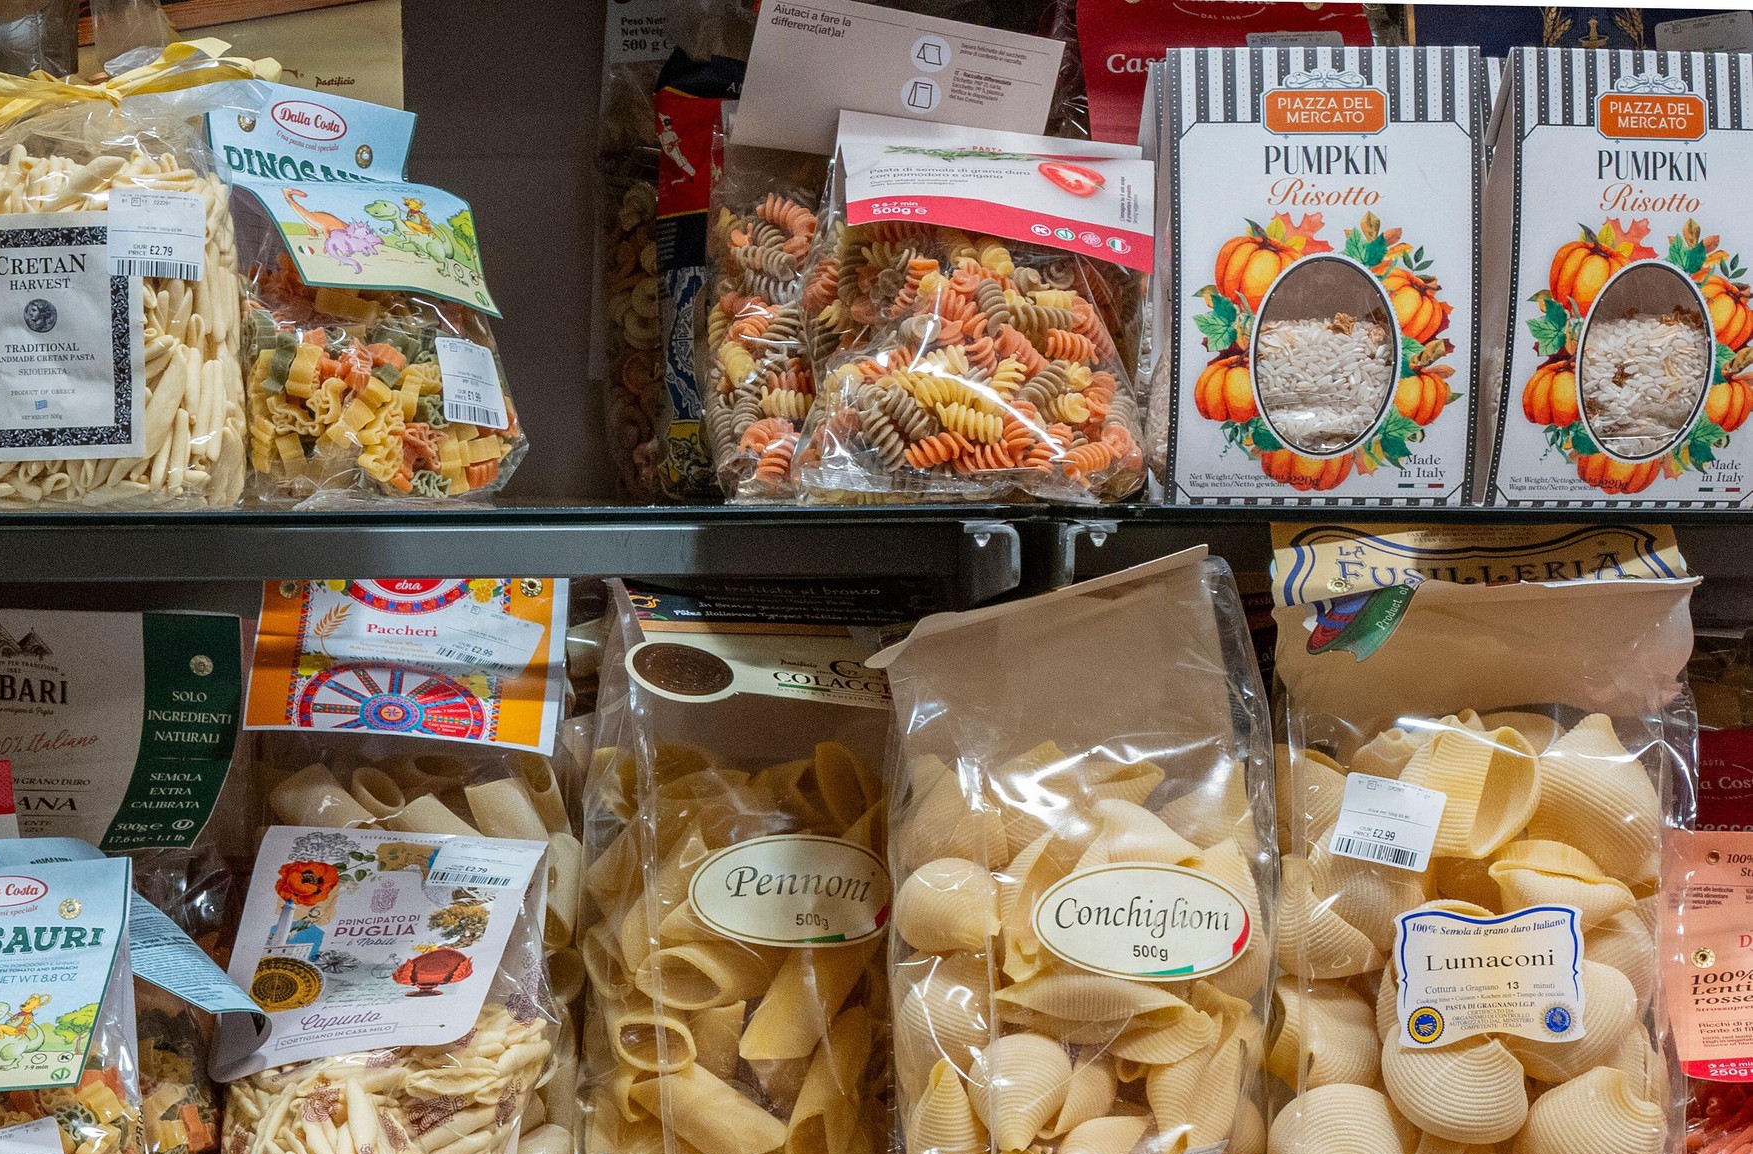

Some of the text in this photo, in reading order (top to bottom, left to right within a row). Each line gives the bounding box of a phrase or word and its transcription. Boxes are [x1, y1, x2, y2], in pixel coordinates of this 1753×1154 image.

[315, 76, 355, 87] Pastificio
[1278, 98, 1373, 110] PIAZZA DEL
[278, 108, 342, 132] Dalla Costa
[1286, 111, 1365, 124] MERCATO
[1265, 145, 1388, 175] PUMPKIN
[1598, 150, 1707, 181] PUMPKIN
[1268, 178, 1384, 207] Risotto
[1600, 184, 1706, 212] Risotto
[149, 245, 173, 256] £2.79
[10, 276, 70, 291] HARVEST
[4, 342, 80, 352] TRADITIONAL
[1405, 455, 1441, 466] Made
[1400, 468, 1445, 479] in Italy
[395, 579, 422, 591] etna
[367, 624, 438, 637] Paccheri
[471, 646, 493, 658] £2.99
[0, 672, 67, 705] BARI
[172, 691, 207, 703] SOLO
[148, 710, 231, 724] INGREDIENTI
[155, 730, 220, 744] NATURALI
[150, 772, 202, 781] SEMOLA
[149, 786, 192, 795] EXTRA
[131, 800, 200, 809] CALIBRATA
[1373, 828, 1395, 841] £2.99
[6, 883, 41, 896] Costa
[726, 865, 875, 903] Pennoni
[338, 915, 420, 926] PRINCIPATO DI
[796, 912, 829, 930] 500g
[1055, 897, 1232, 938] Conchiglioni
[334, 923, 416, 938] PUGLIA
[1133, 944, 1168, 961] 500g
[1425, 950, 1555, 972] Lumaconi
[40, 973, 59, 982] 8.8
[62, 972, 76, 981] OZ
[1507, 981, 1519, 990] 13
[300, 1010, 382, 1031] Capunto
